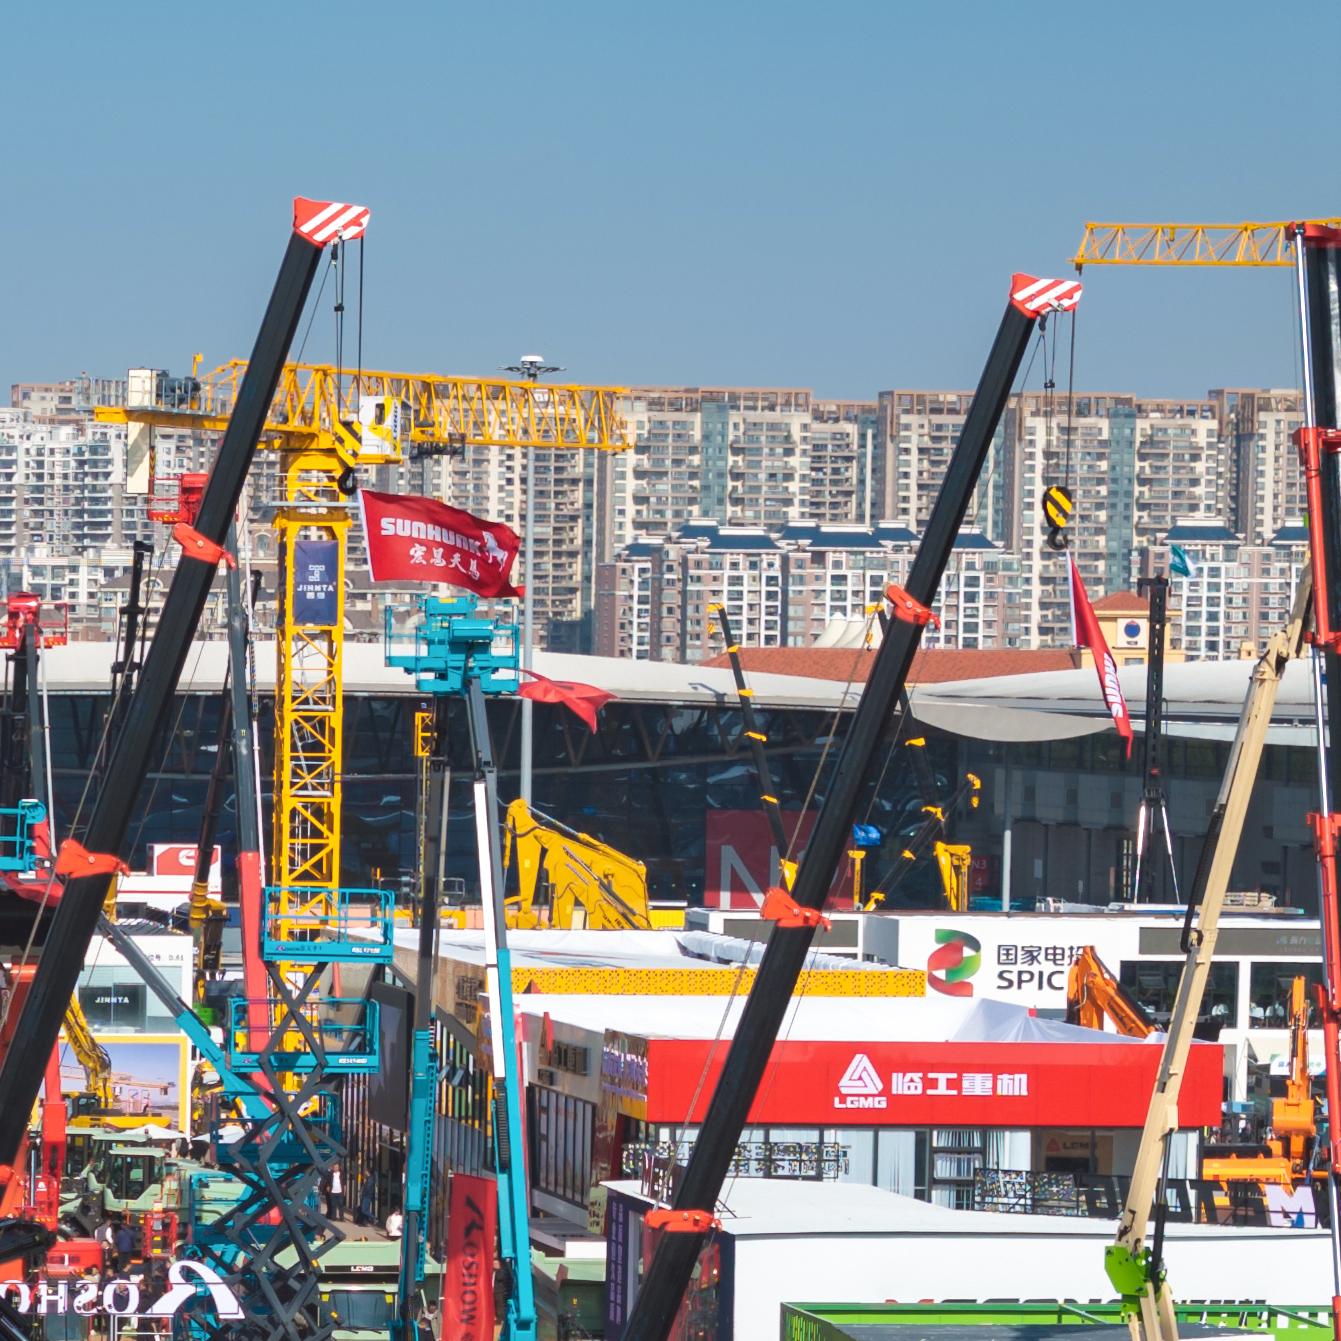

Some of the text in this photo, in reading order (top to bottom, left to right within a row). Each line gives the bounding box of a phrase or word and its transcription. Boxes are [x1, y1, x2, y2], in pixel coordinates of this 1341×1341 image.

[380, 517, 481, 557] SUNHUNK
[996, 969, 1065, 991] SPIC
[891, 1071, 1028, 1096] 临工重机
[834, 1095, 887, 1109] LGMG
